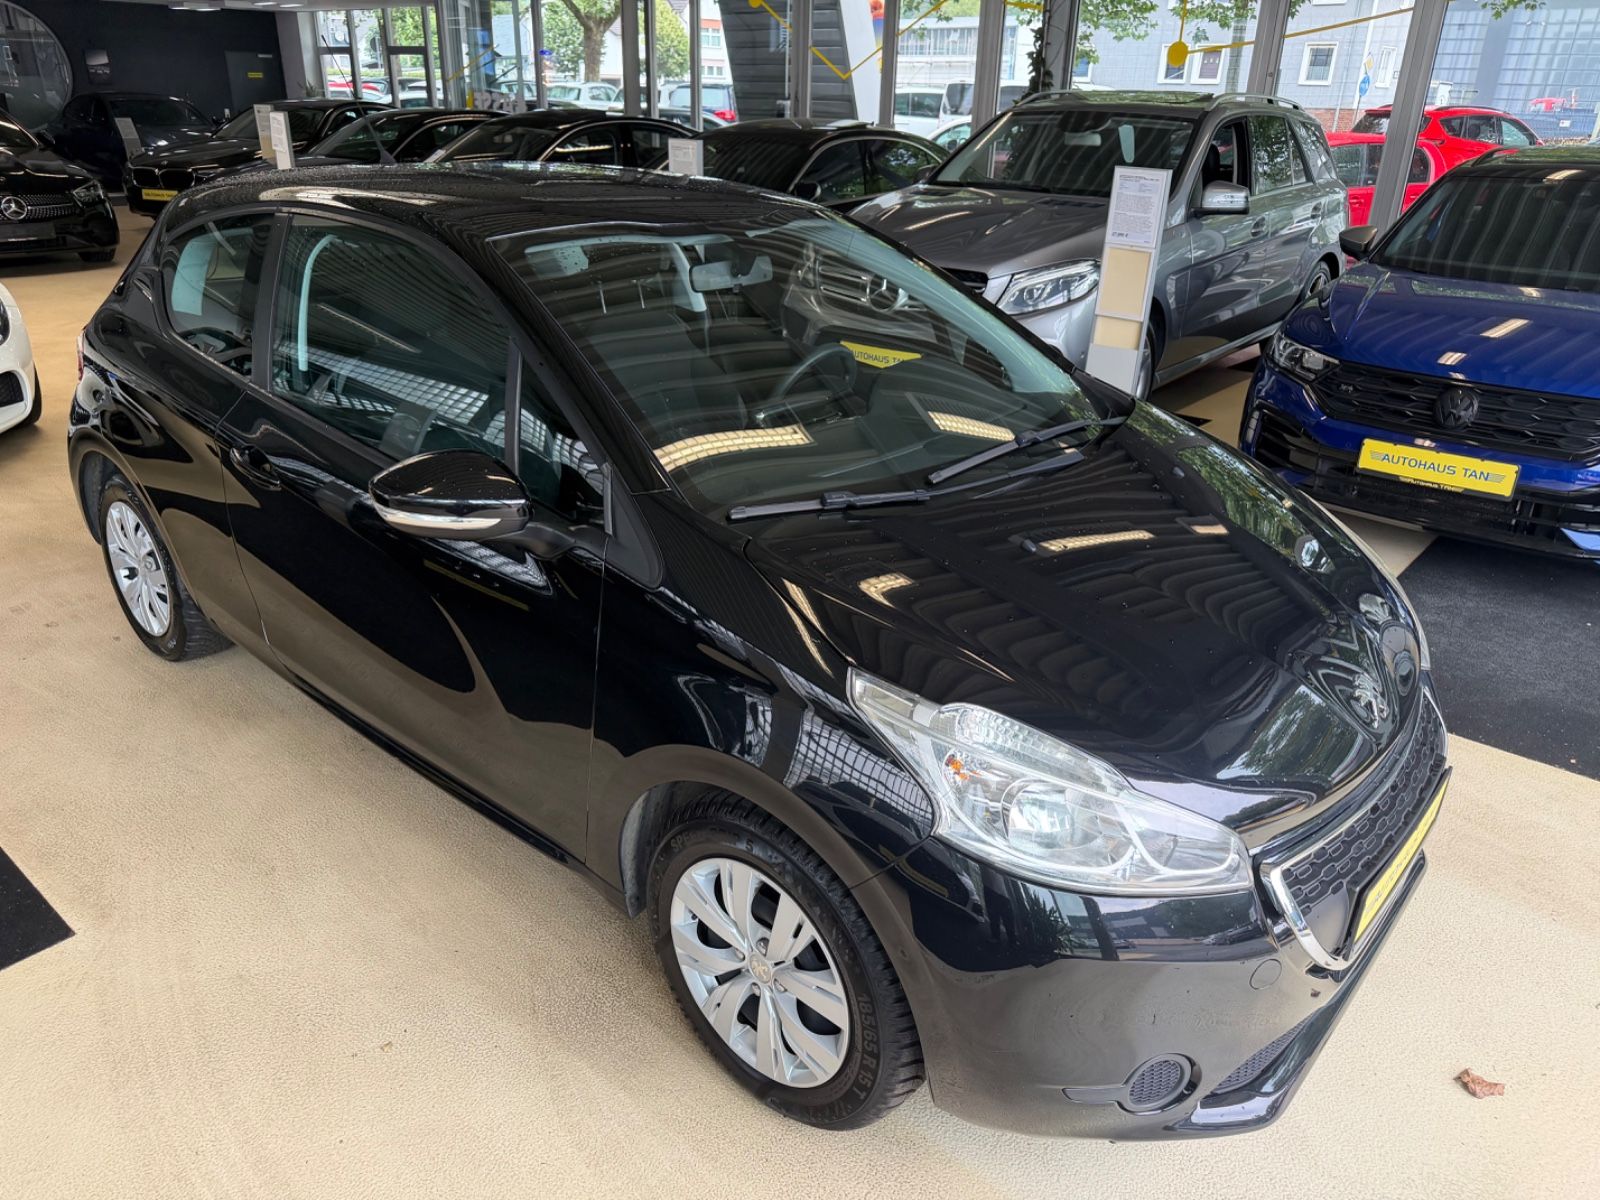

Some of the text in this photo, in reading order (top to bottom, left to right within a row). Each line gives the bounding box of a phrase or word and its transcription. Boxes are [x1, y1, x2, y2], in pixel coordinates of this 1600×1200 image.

[854, 351, 890, 364] UTOHAUS
[1381, 453, 1490, 481] AUTOHAUS TAN
